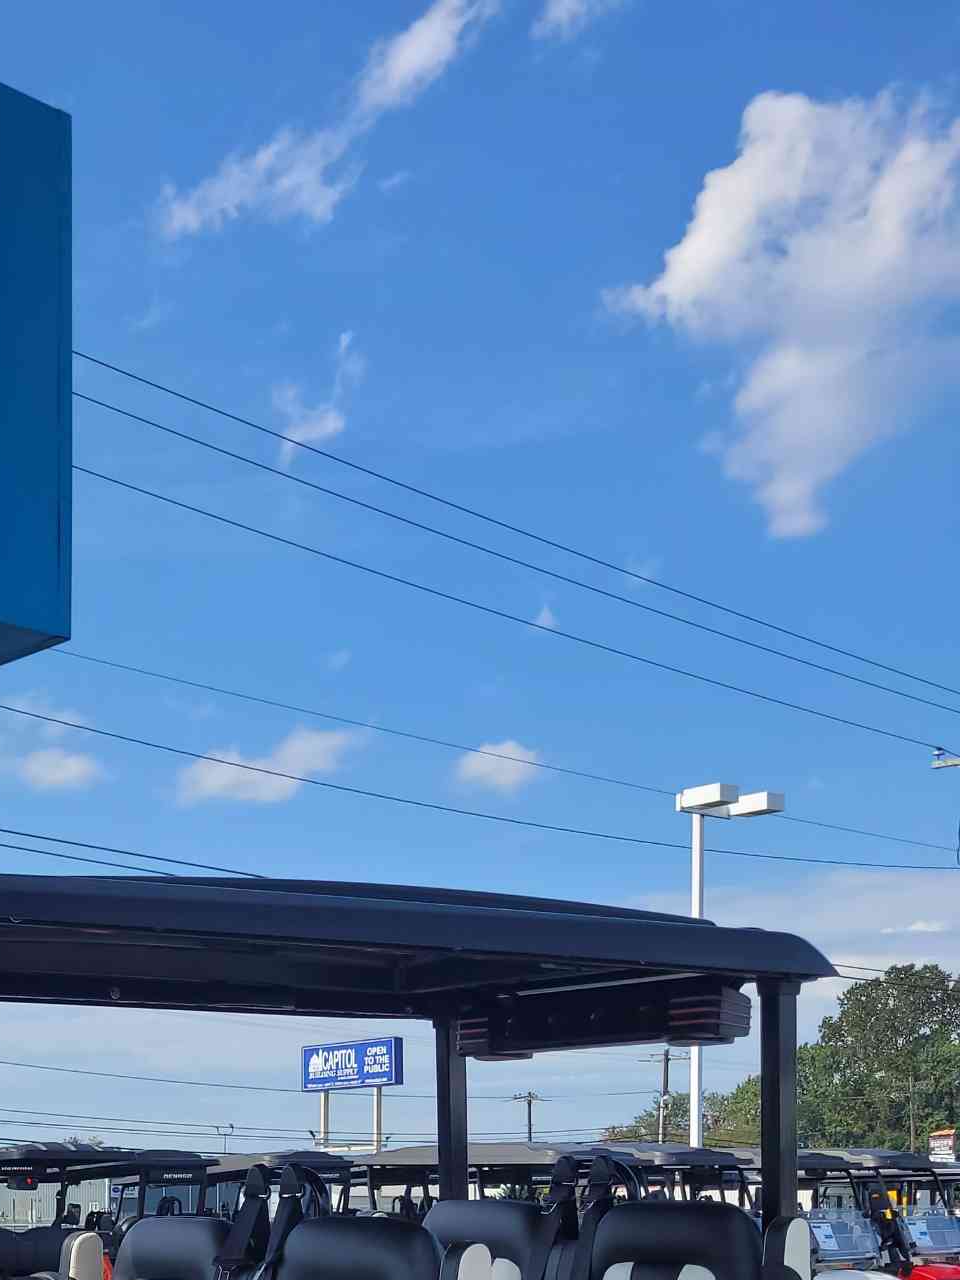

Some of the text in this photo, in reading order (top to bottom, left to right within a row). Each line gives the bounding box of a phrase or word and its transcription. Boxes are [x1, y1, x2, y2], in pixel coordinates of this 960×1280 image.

[366, 1046, 387, 1055] OPEN
[322, 1048, 358, 1070] CAPITOL
[364, 1055, 390, 1064] TO THE
[364, 1064, 390, 1073] PUBLIC
